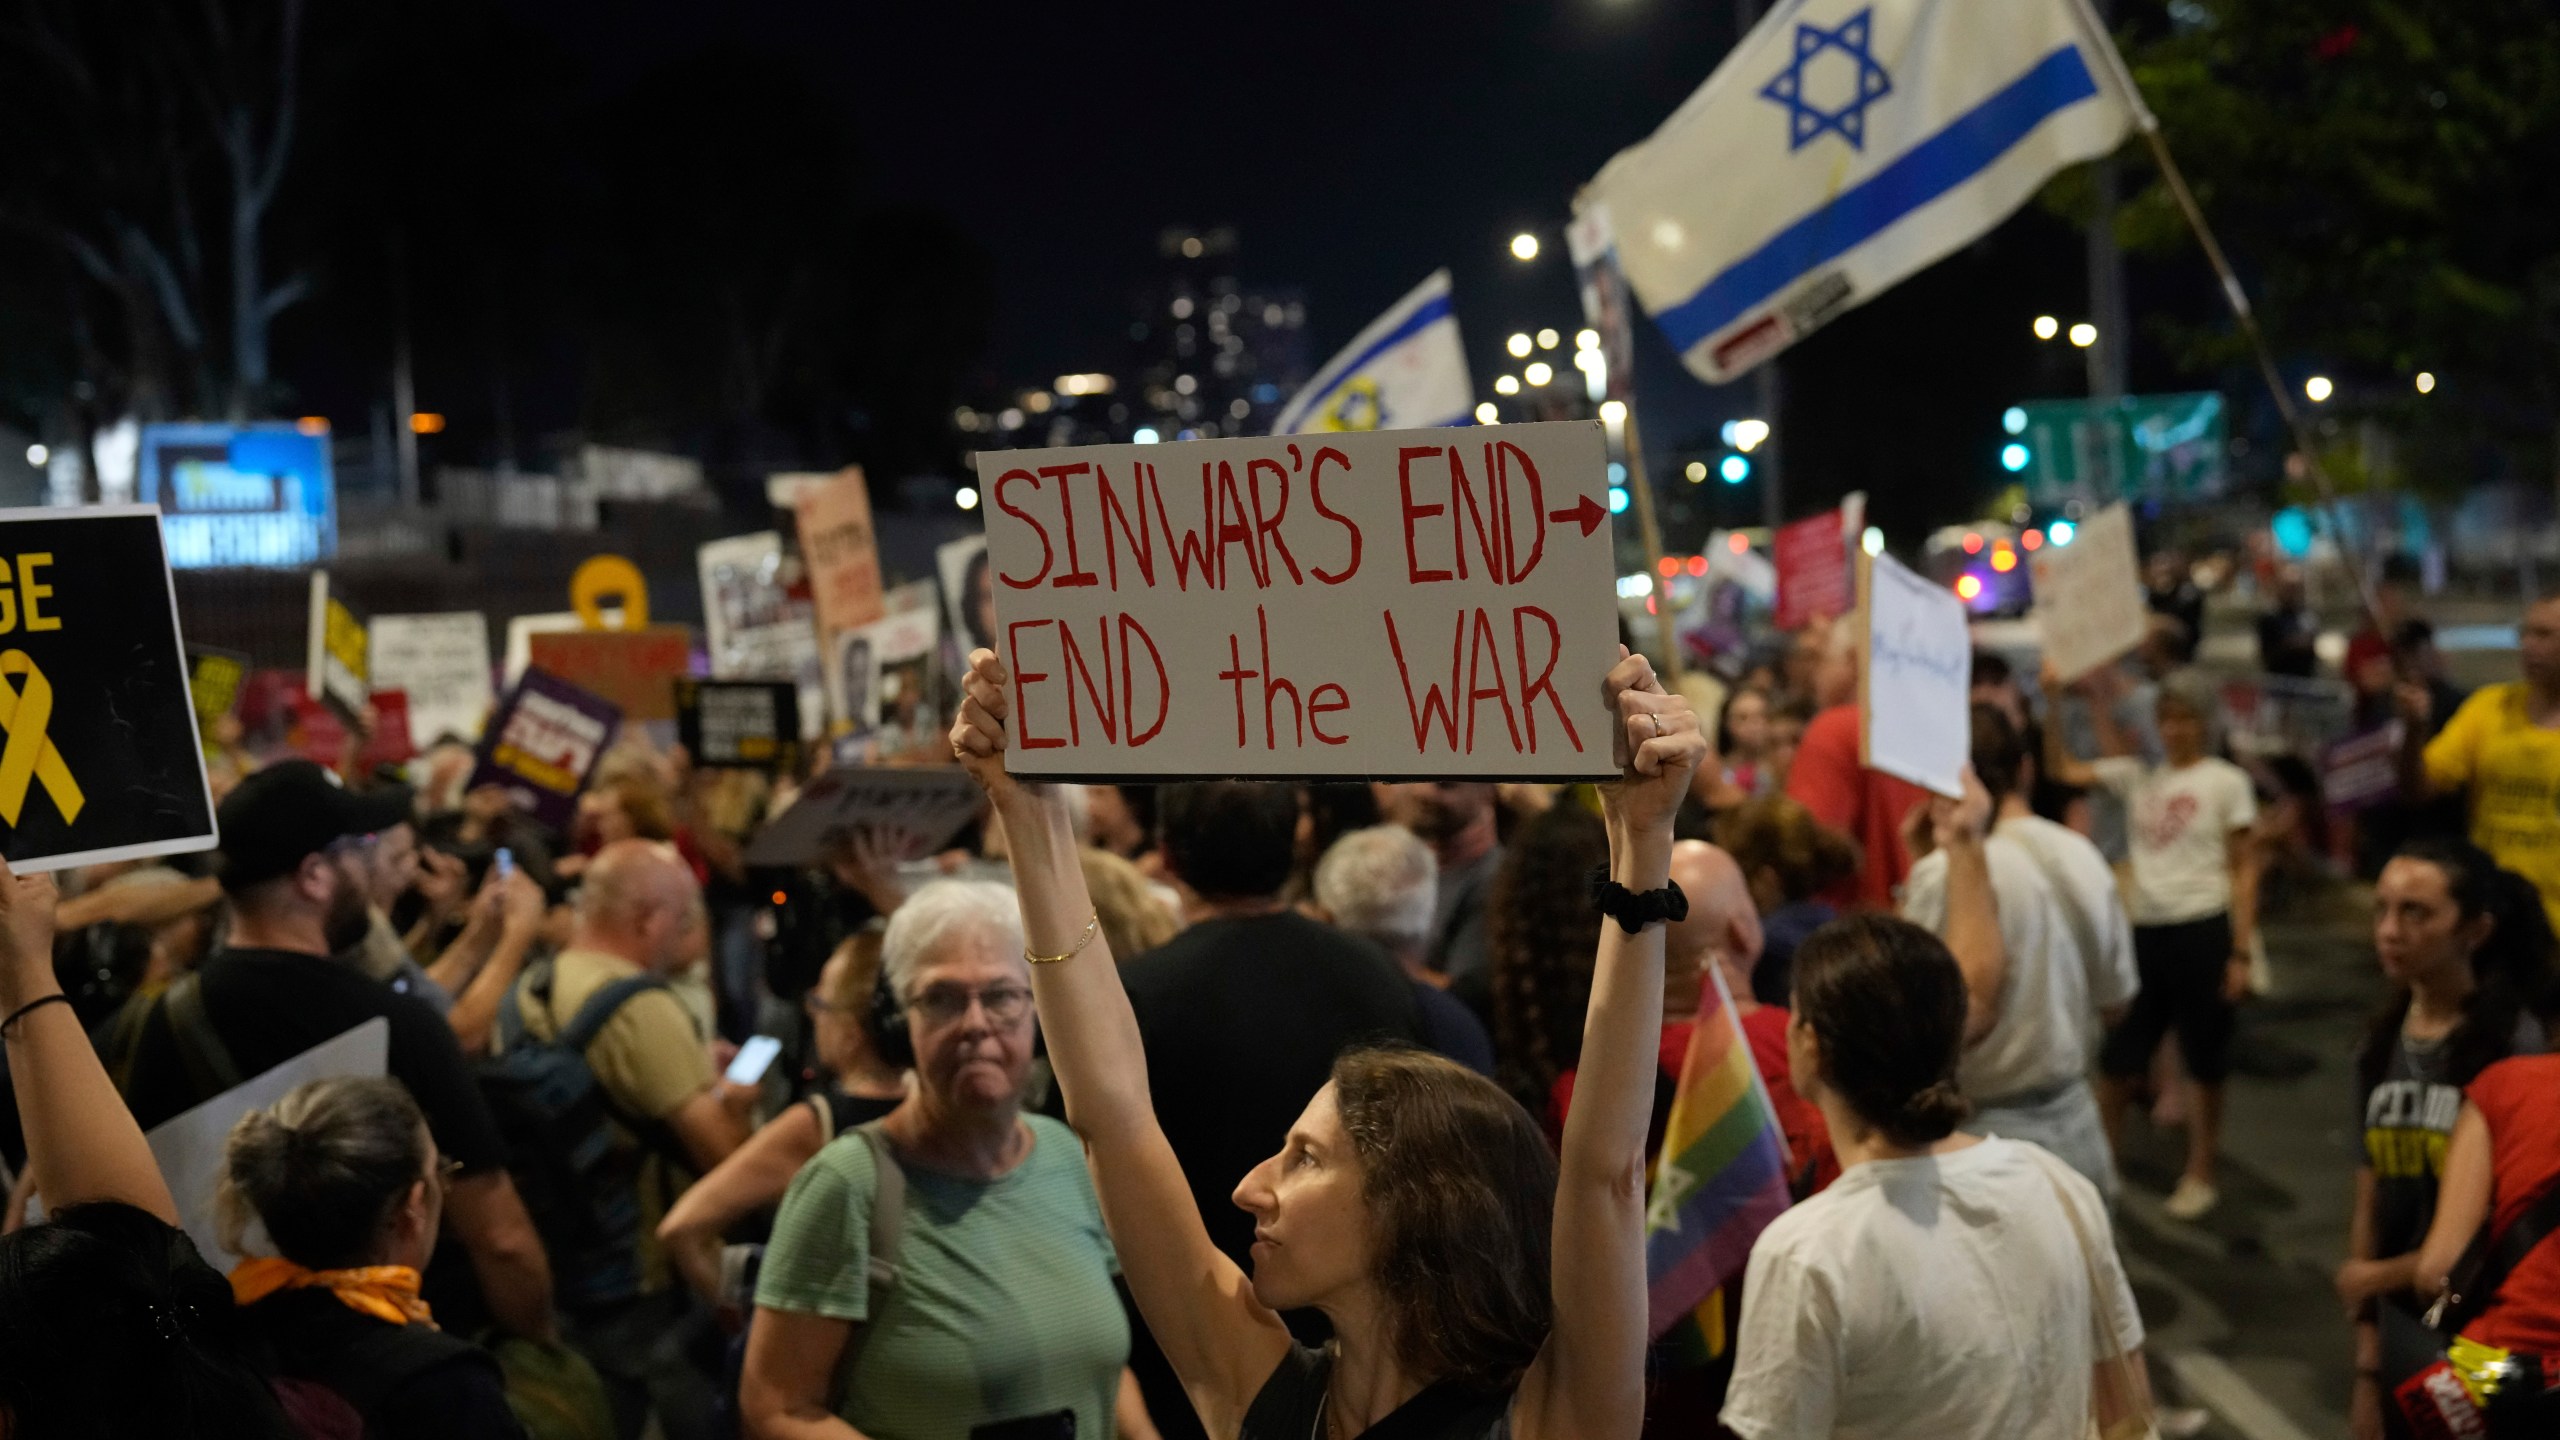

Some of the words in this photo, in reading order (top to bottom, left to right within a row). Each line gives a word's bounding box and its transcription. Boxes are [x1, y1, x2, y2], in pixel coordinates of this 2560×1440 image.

[994, 444, 1363, 592] SINWAR'S
[1399, 441, 1545, 585] END
[1009, 612, 1170, 750] END
[1218, 605, 1350, 750] the
[1384, 605, 1584, 754] WAR
